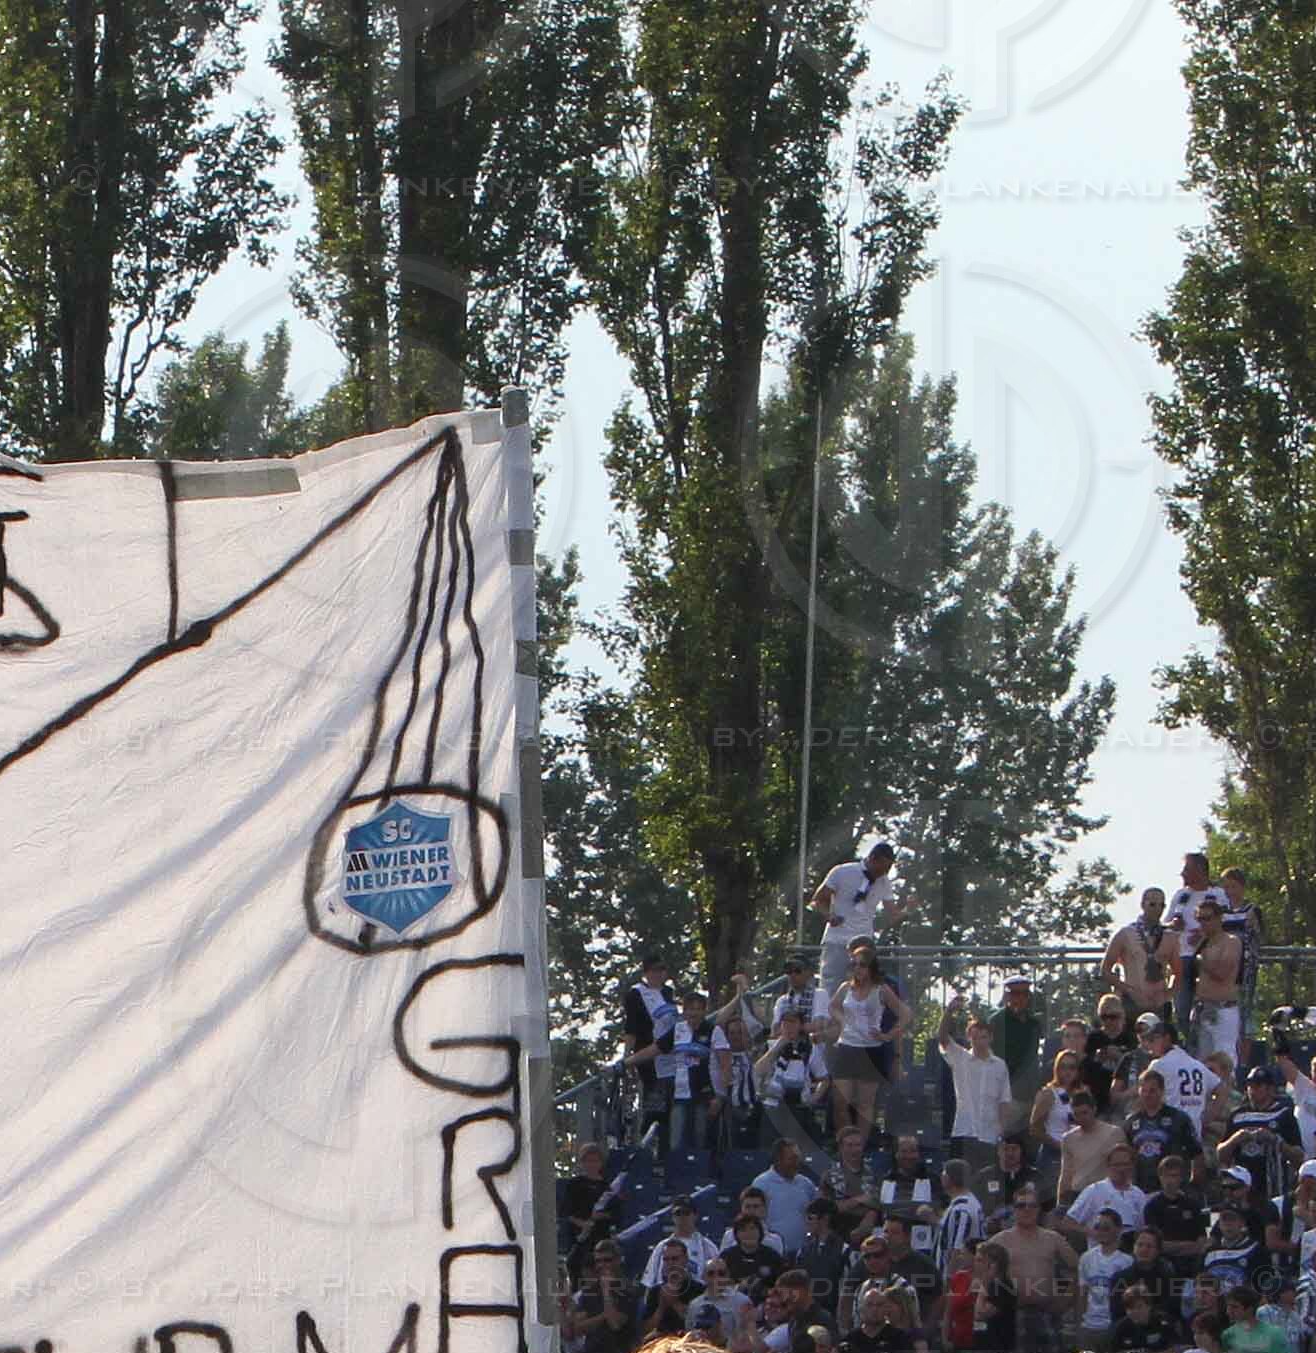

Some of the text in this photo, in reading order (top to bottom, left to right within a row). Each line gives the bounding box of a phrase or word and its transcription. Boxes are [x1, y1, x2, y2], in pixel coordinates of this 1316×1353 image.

[381, 818, 412, 843] SC
[372, 846, 449, 868] WIENER
[346, 865, 451, 891] NEUSTADT
[1178, 1068, 1203, 1096] 28
